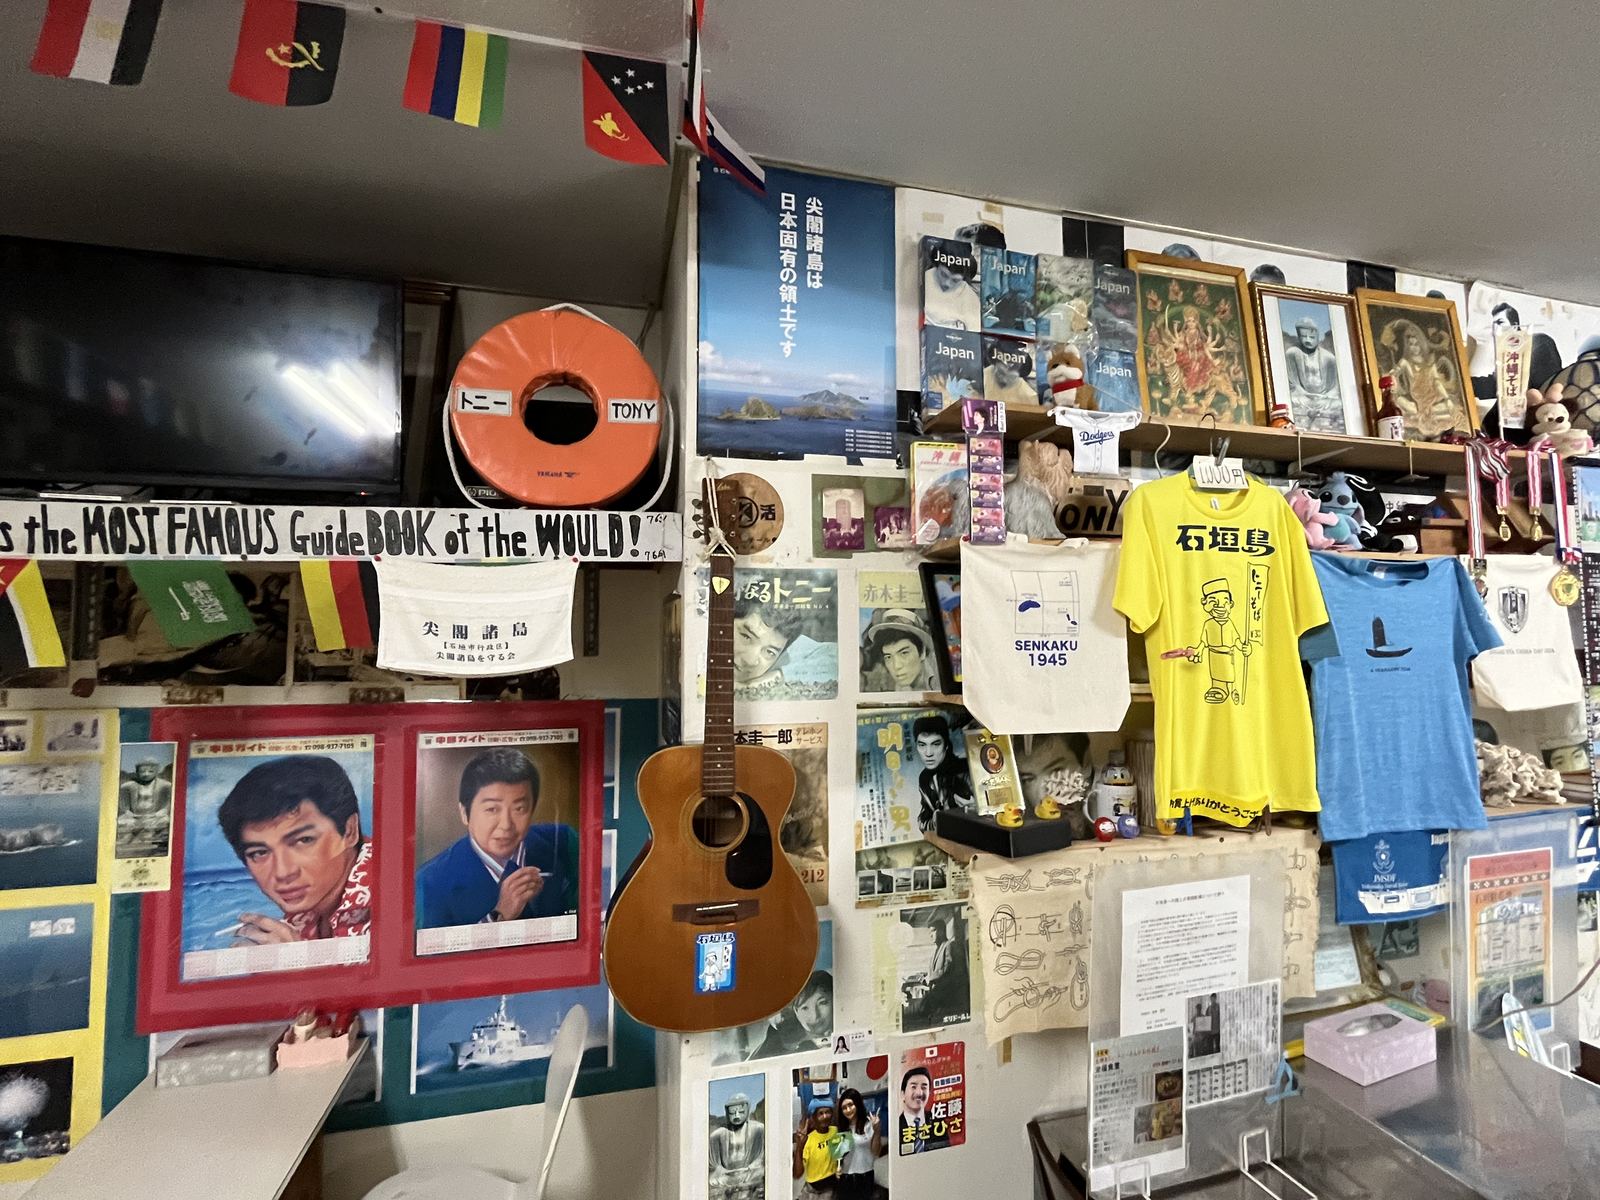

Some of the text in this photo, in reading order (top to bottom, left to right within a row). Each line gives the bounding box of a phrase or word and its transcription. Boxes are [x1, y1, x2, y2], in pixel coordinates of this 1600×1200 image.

[805, 196, 824, 289] 尖閣諸島は
[934, 250, 971, 267] Japan
[991, 259, 1026, 275] Japan
[779, 192, 798, 358] 日本固有の領土です
[1094, 277, 1130, 295] Japan
[935, 342, 975, 360] Japan
[991, 348, 1026, 364] Japan
[1095, 362, 1132, 378] Japan
[1506, 352, 1520, 397] 沖縄そば
[461, 391, 507, 410] トニー
[611, 402, 657, 420] TONY
[1080, 430, 1115, 446] Dodgers
[1053, 487, 1129, 532] ONY
[24, 503, 77, 555] the
[83, 505, 160, 555] MOST
[167, 506, 279, 556] FAMOUS
[445, 512, 471, 555] of
[478, 512, 527, 558] the
[1175, 525, 1276, 557] 石垣島
[735, 576, 832, 604] なるトニー
[863, 583, 923, 604] 赤木圭一
[422, 621, 528, 640] 尖閣諸島
[1014, 640, 1079, 652] SENKAKU
[1028, 653, 1068, 667] 1945
[902, 1117, 963, 1143] まさひさ
